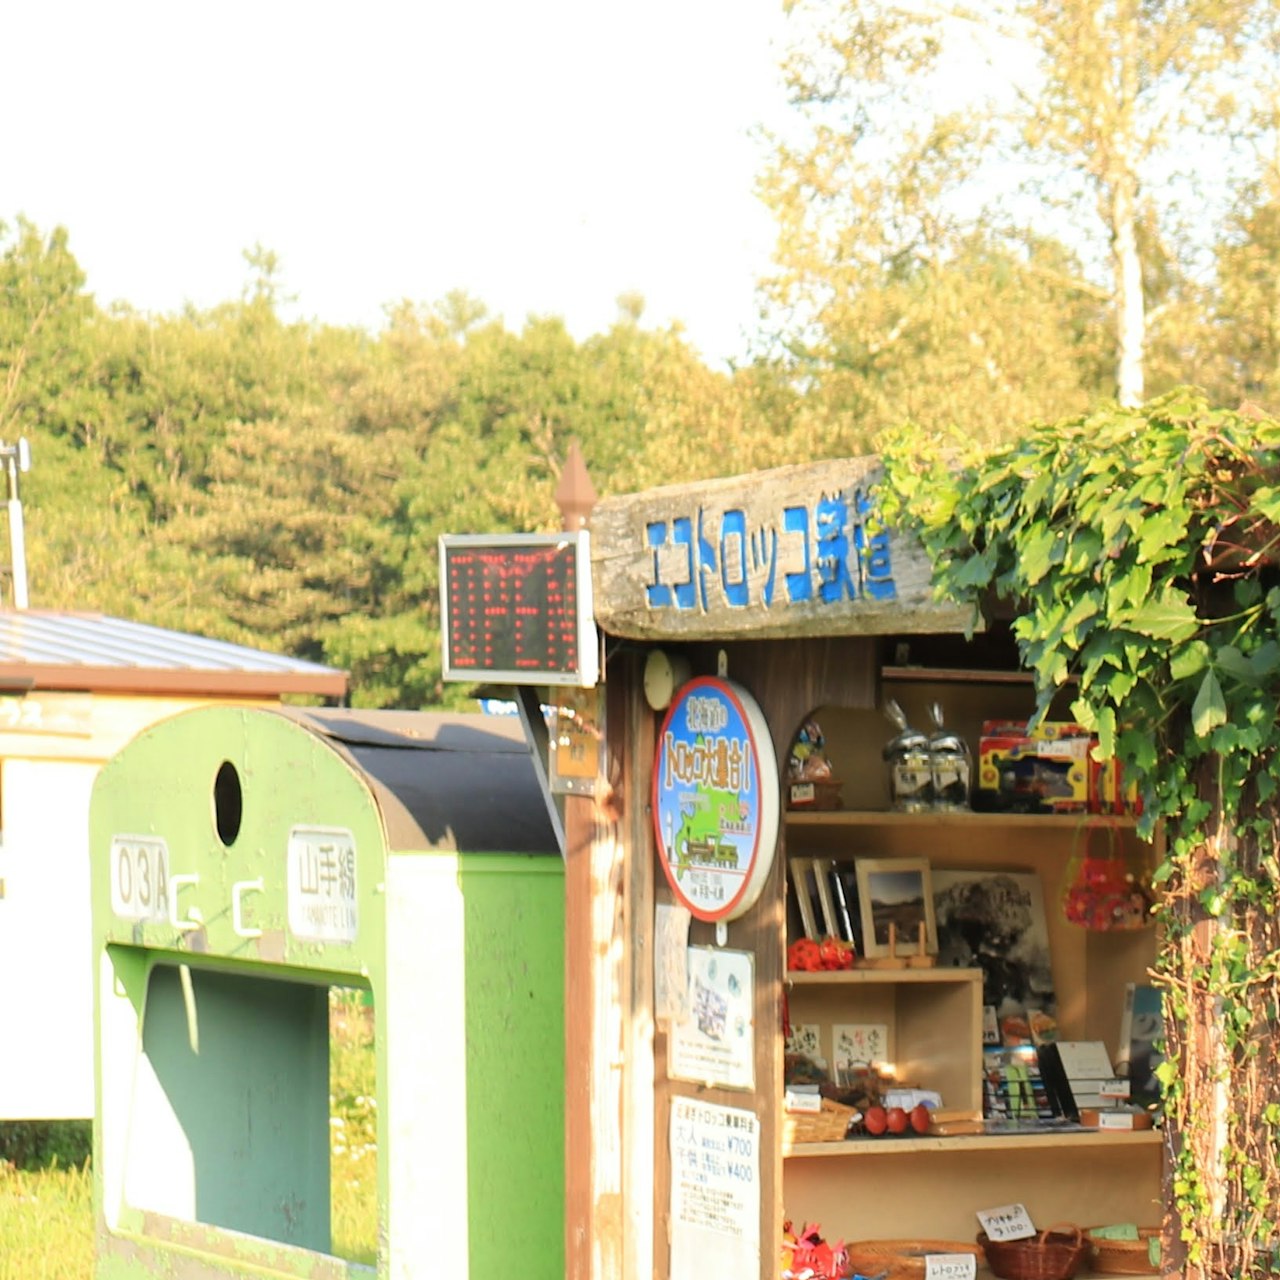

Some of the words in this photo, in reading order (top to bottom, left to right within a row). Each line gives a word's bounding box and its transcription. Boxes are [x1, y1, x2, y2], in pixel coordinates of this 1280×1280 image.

[450, 553, 577, 668] OPEN
[118, 846, 168, 911] 03A
[728, 1136, 752, 1157] ¥700
[728, 1161, 753, 1182] ¥400
